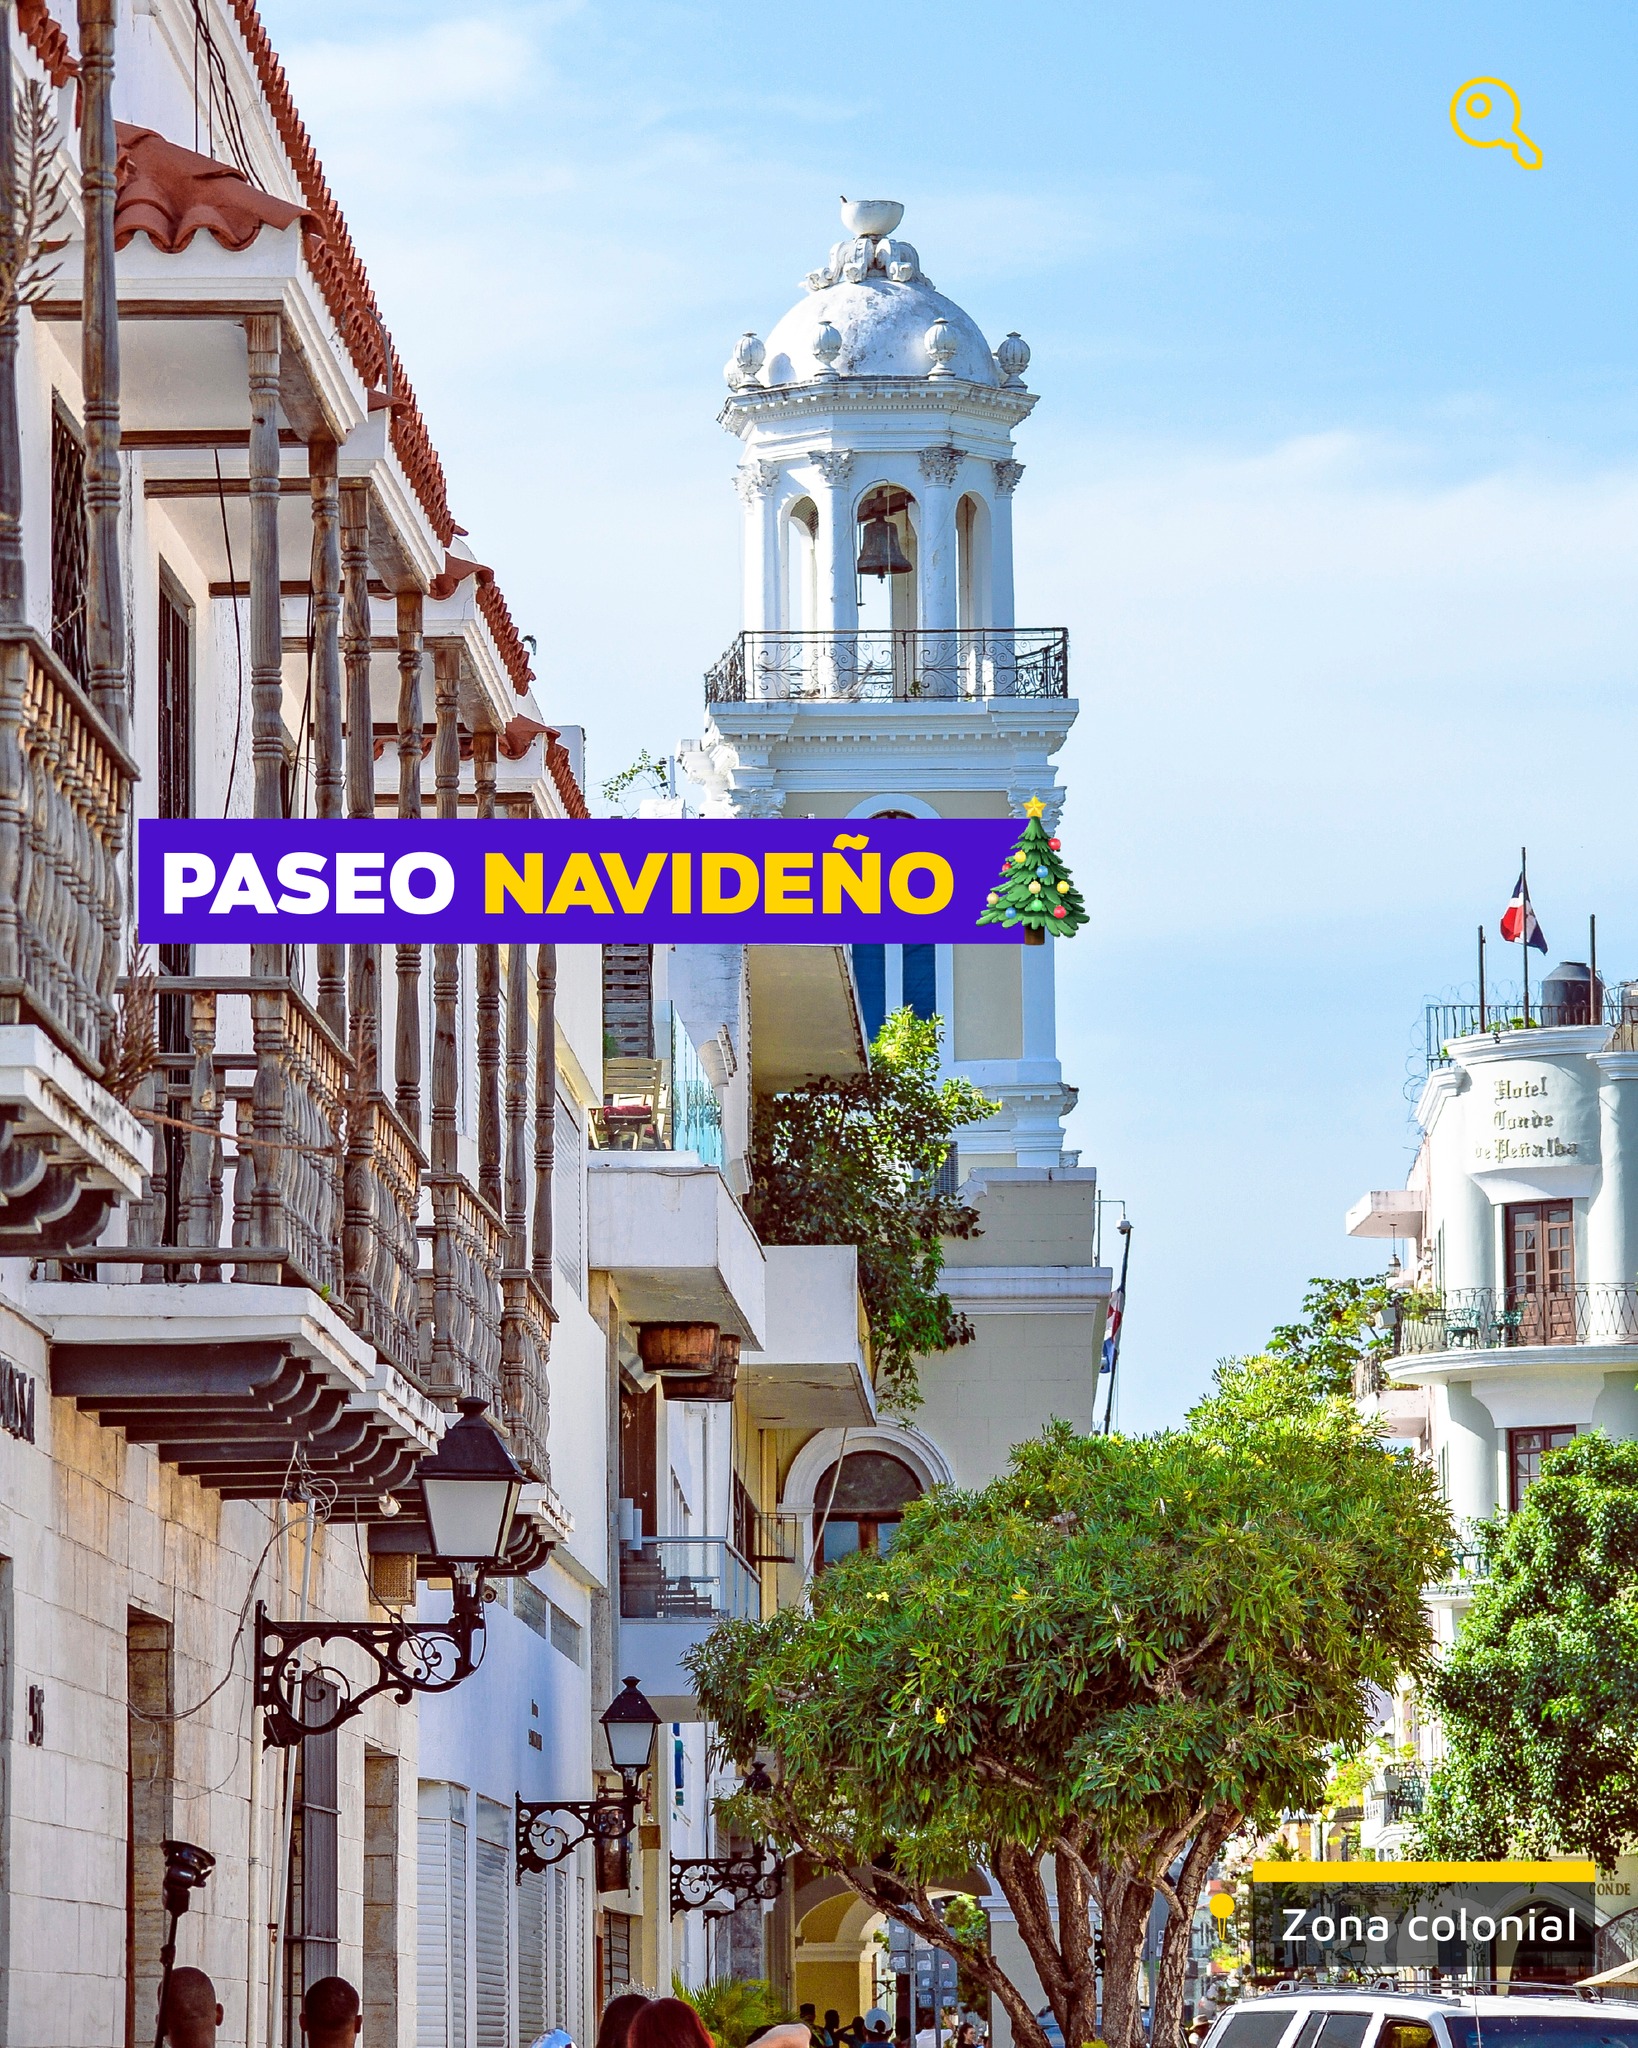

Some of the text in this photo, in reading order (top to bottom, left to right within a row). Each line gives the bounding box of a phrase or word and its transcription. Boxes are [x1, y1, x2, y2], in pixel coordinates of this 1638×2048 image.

[1494, 1076, 1548, 1106] Hotel
[1494, 1110, 1554, 1130] Conde
[1589, 1882, 1631, 1896] CONDE
